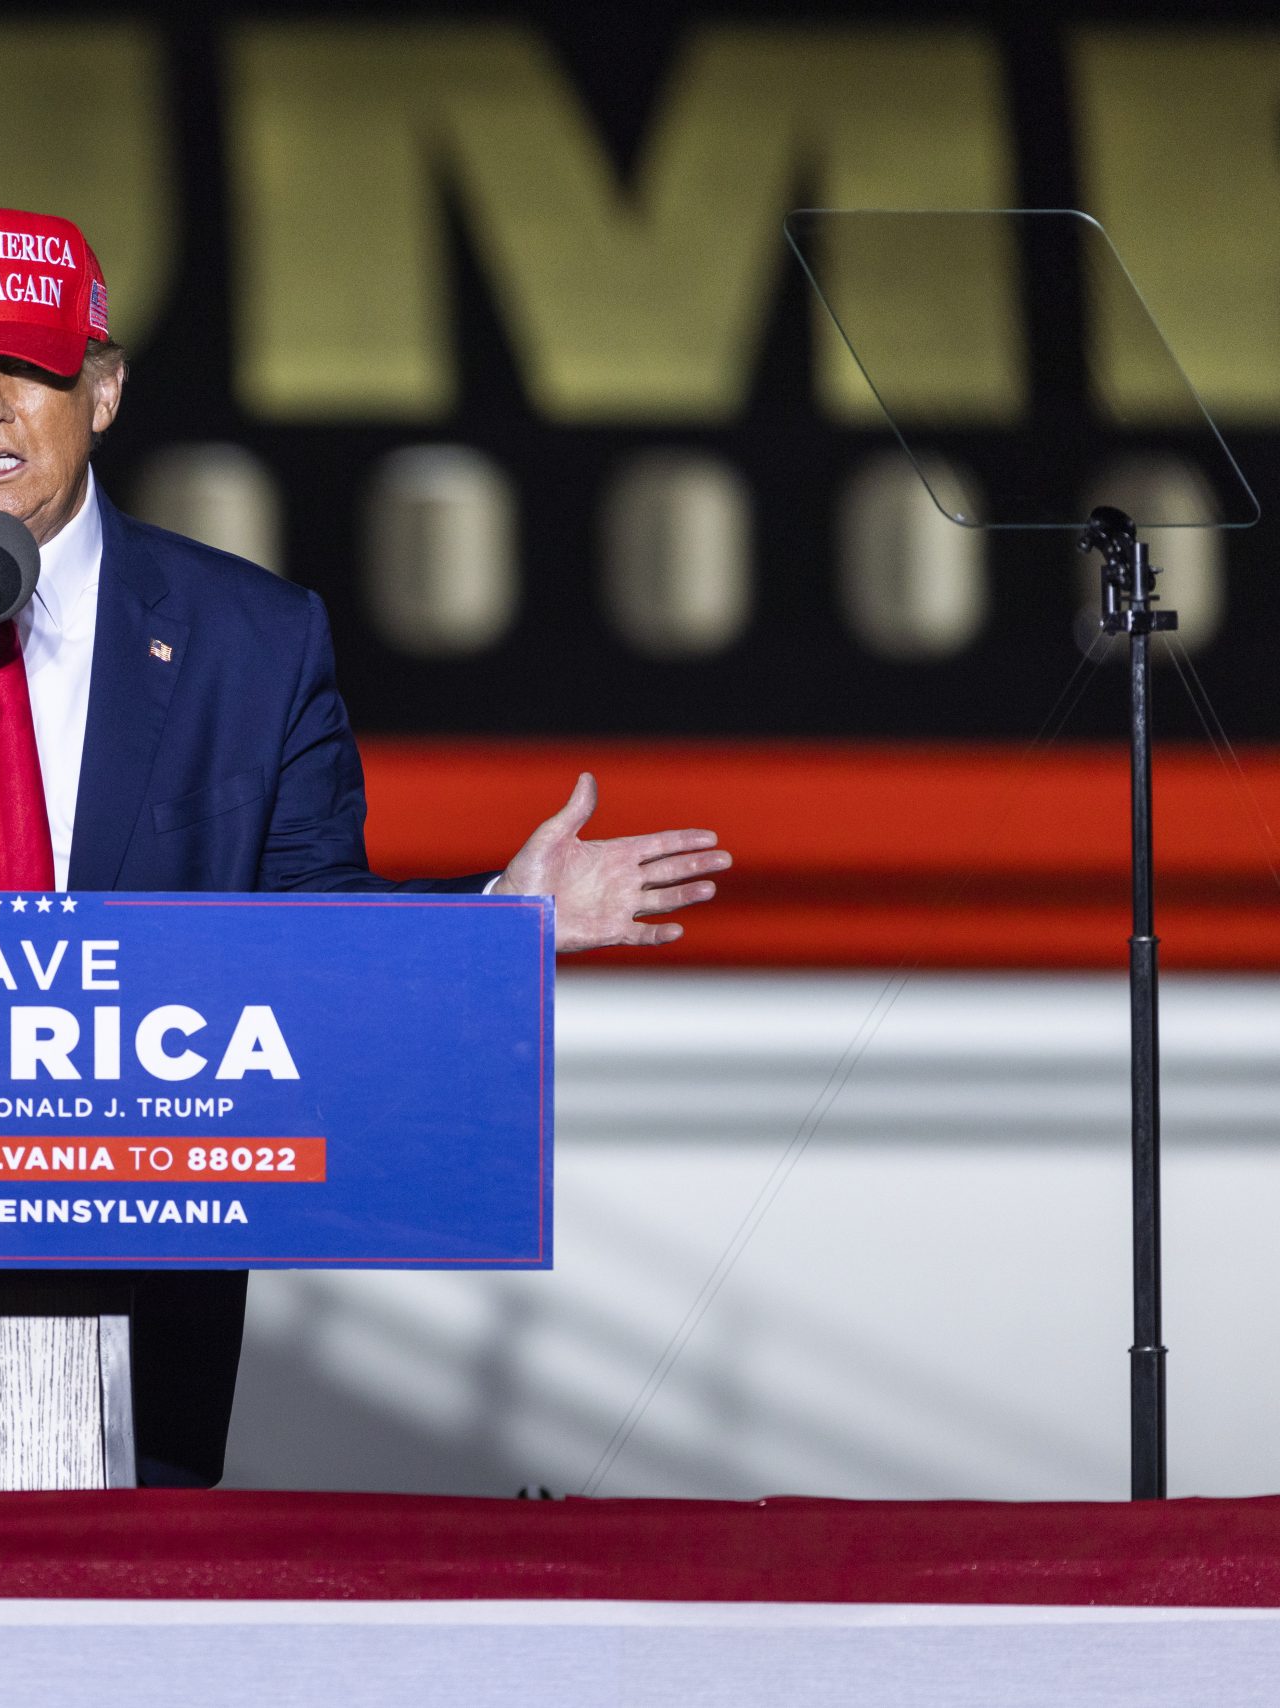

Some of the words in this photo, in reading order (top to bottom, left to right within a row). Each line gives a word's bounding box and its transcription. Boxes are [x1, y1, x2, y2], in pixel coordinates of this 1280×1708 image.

[103, 1096, 126, 1119] J.
[136, 1096, 235, 1119] TRUMP
[128, 1146, 174, 1171] TO
[187, 1146, 296, 1172] 88022
